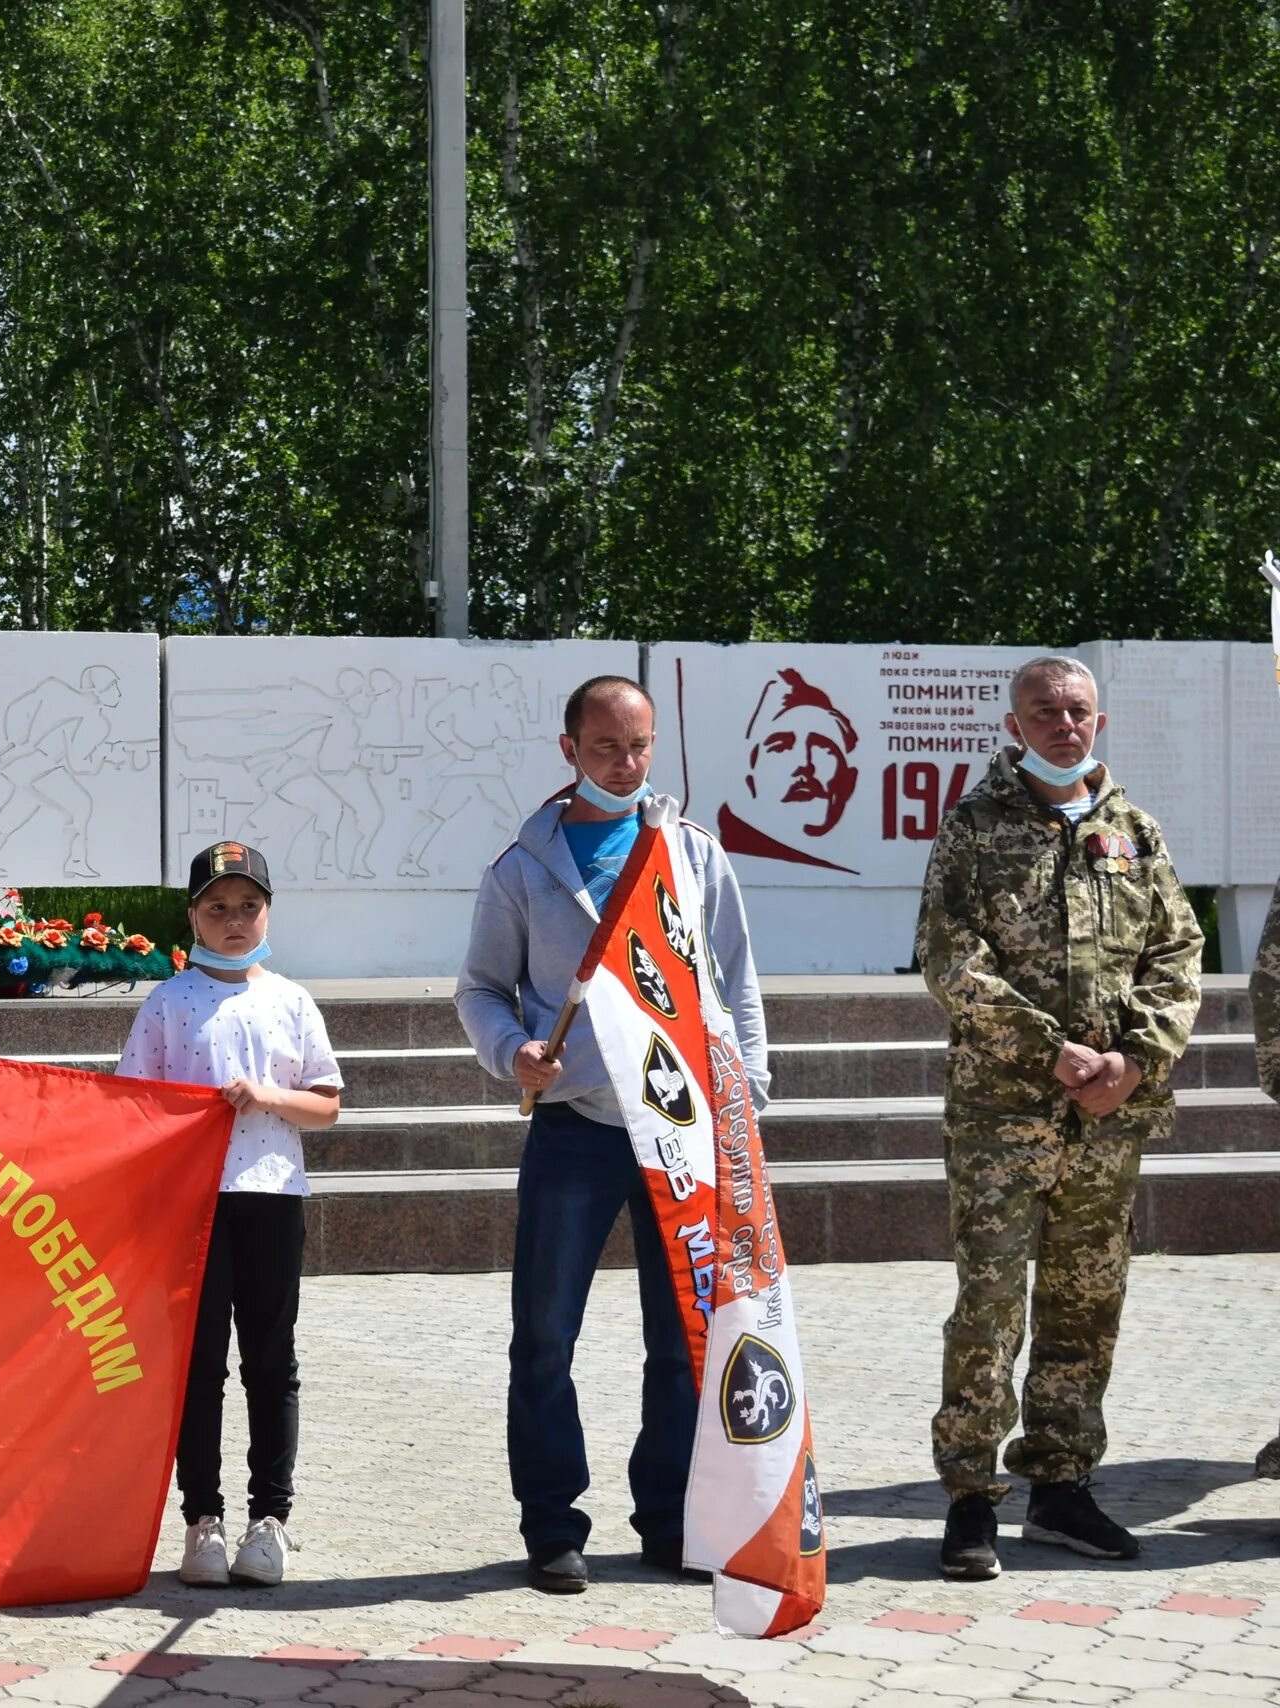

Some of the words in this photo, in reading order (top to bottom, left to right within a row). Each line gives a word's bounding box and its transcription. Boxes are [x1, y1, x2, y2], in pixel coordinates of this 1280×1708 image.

[882, 651, 919, 660] ЛЮДИ
[880, 668, 909, 677] ПОКА
[913, 668, 957, 678] СЕРДЦА
[888, 684, 1000, 701] ПОМНИТЕ!
[893, 705, 932, 715] КАКОЙ
[935, 705, 974, 716] ЦЕНОЙ
[880, 722, 945, 731] ЗАВОЕВАНО
[950, 722, 1001, 732] СЧАСТЬЕ
[888, 736, 998, 754] ПОМНИТЕ!
[655, 1126, 697, 1202] ВВ
